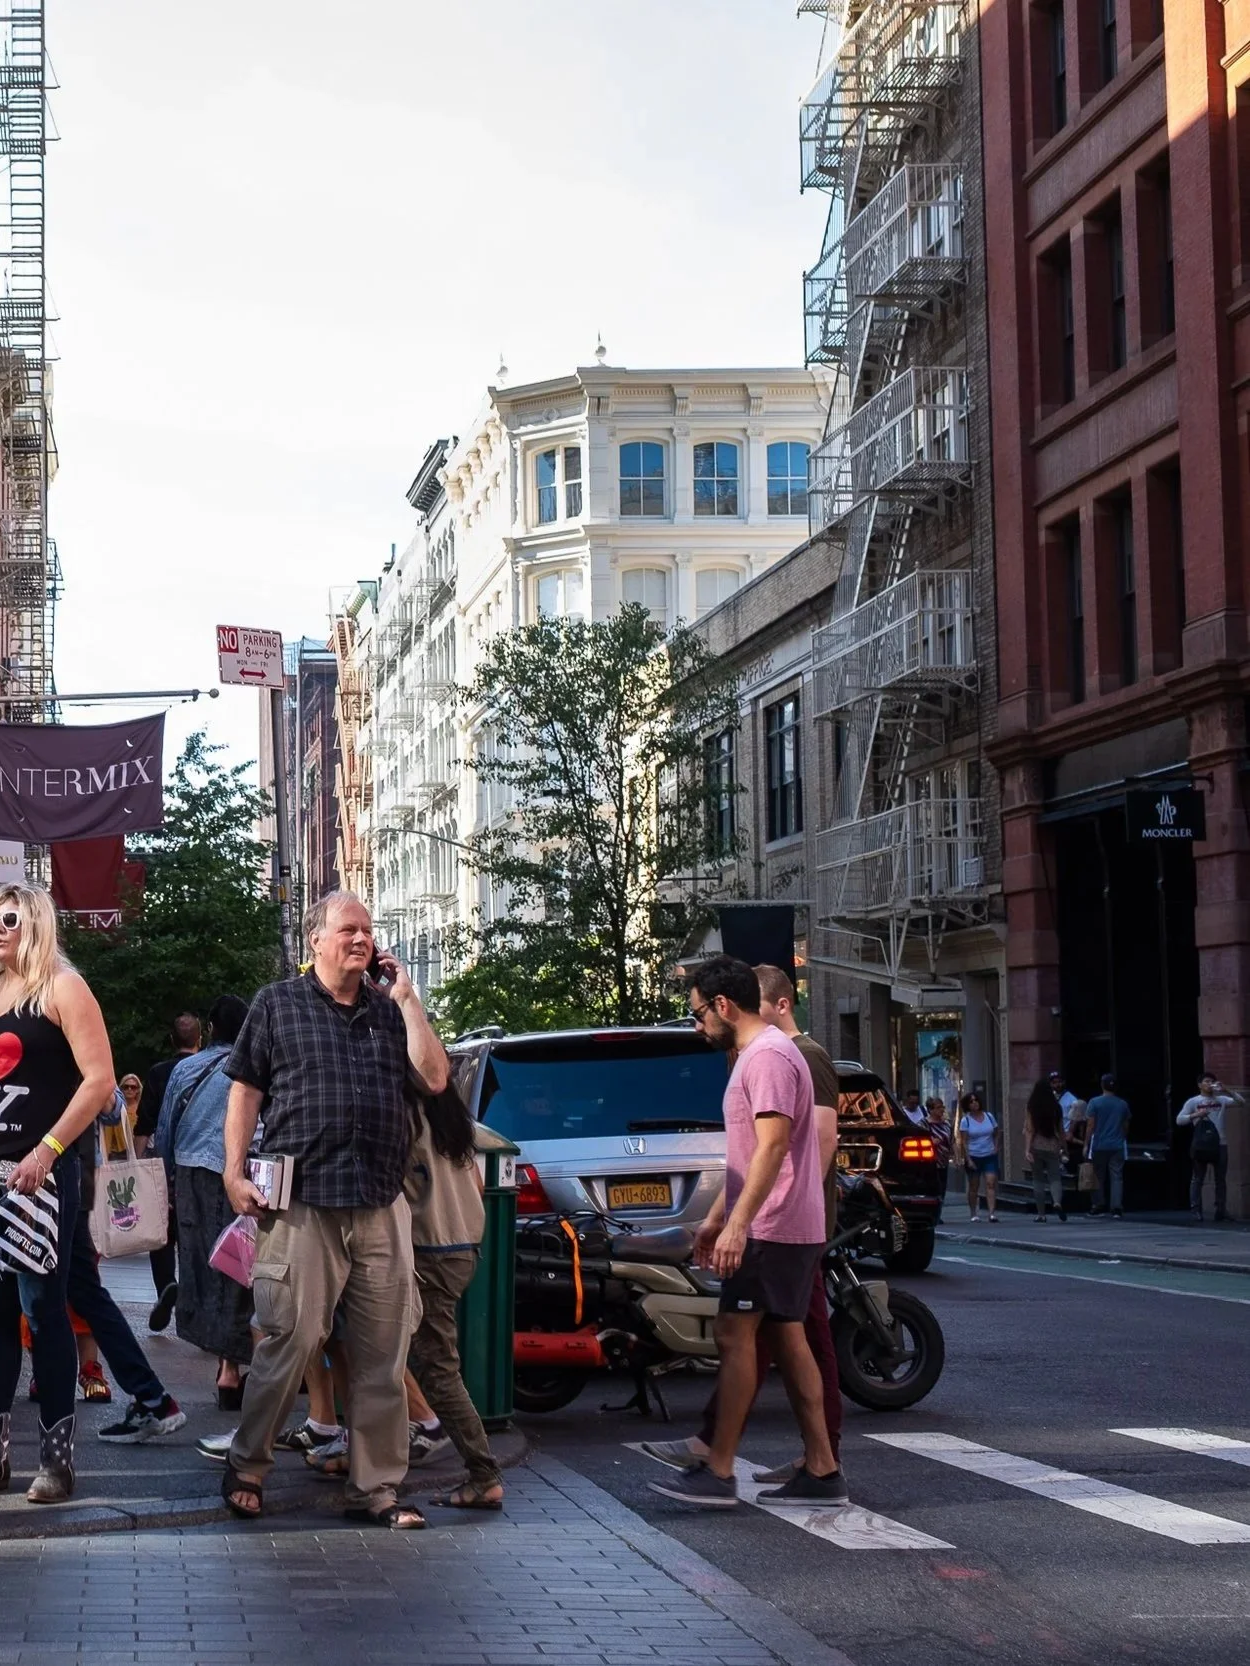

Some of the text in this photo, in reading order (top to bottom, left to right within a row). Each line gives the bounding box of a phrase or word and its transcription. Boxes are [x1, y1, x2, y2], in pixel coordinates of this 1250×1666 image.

[219, 629, 277, 650] NO PARKING
[1141, 828, 1193, 838] MONCLER
